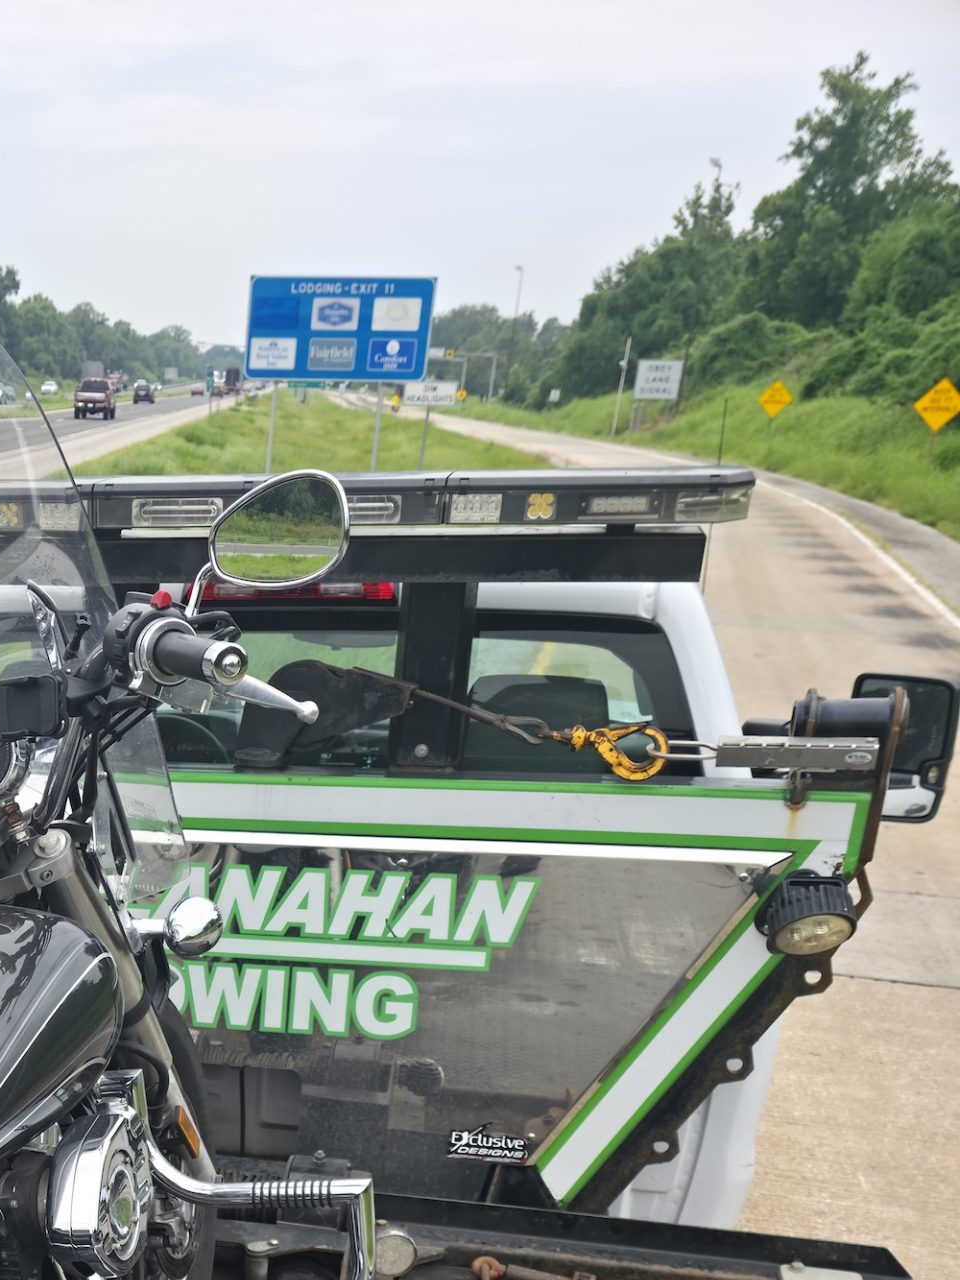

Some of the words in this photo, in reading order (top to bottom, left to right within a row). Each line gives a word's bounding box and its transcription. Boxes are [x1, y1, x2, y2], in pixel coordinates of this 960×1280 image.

[384, 283, 395, 295] 11
[127, 862, 542, 948] ANAHAN
[457, 1146, 524, 1159] DESIGNS
